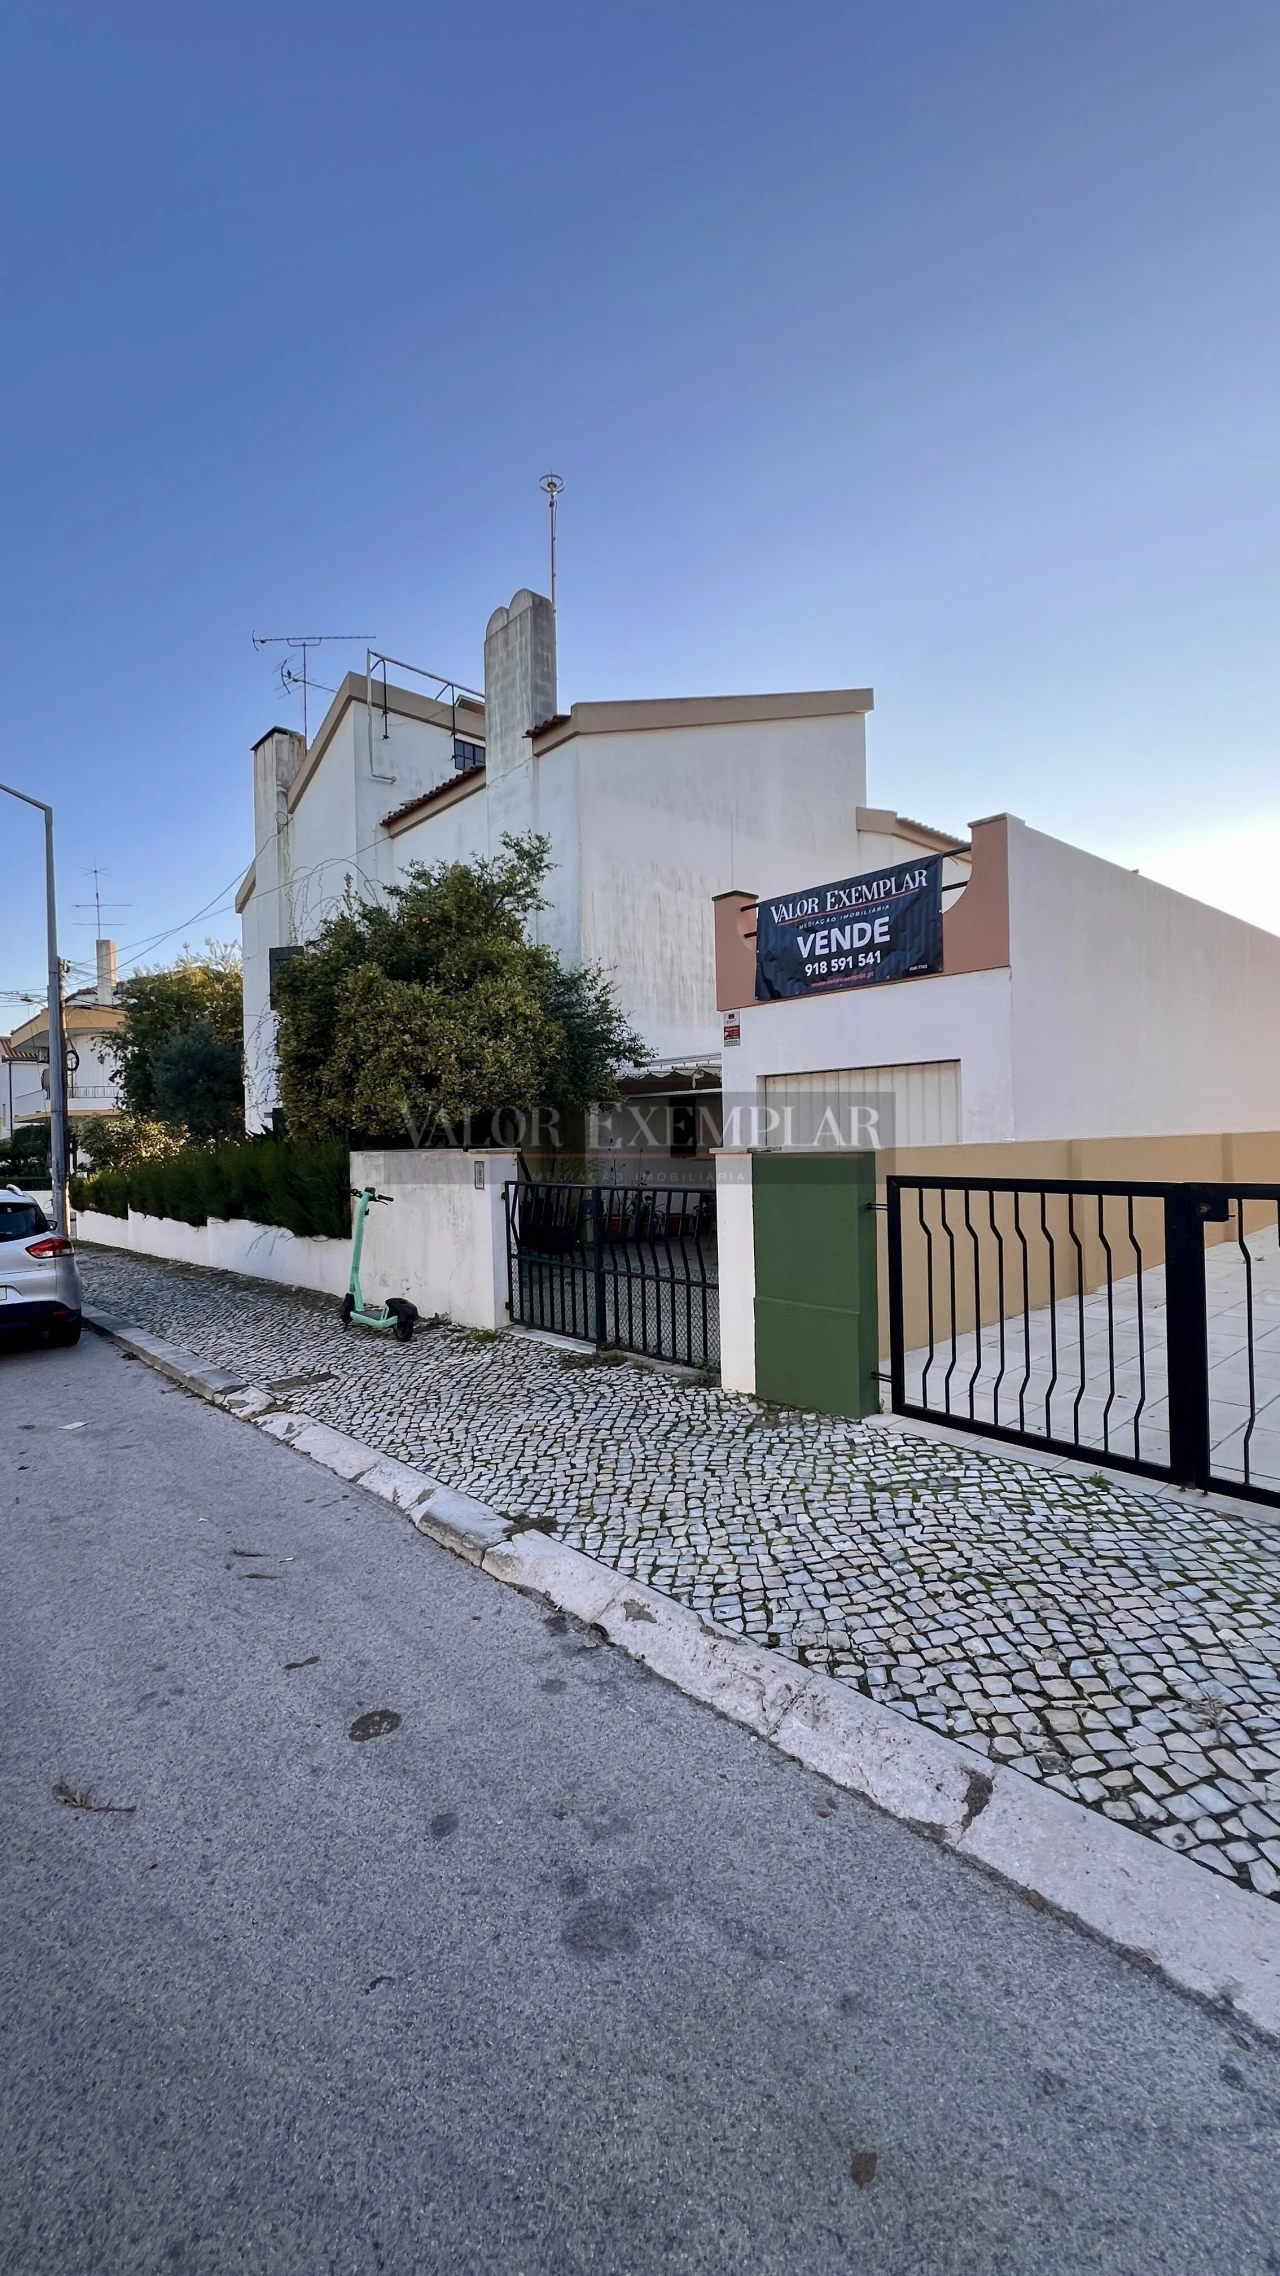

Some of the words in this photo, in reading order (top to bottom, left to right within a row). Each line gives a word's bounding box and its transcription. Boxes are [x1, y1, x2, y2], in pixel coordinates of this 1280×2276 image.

[770, 898, 819, 924] VALOR
[826, 869, 928, 912] EXEMPLAR
[797, 916, 891, 959] VENDE
[804, 961, 827, 977] 918
[830, 956, 853, 972] 591
[858, 950, 882, 966] 541
